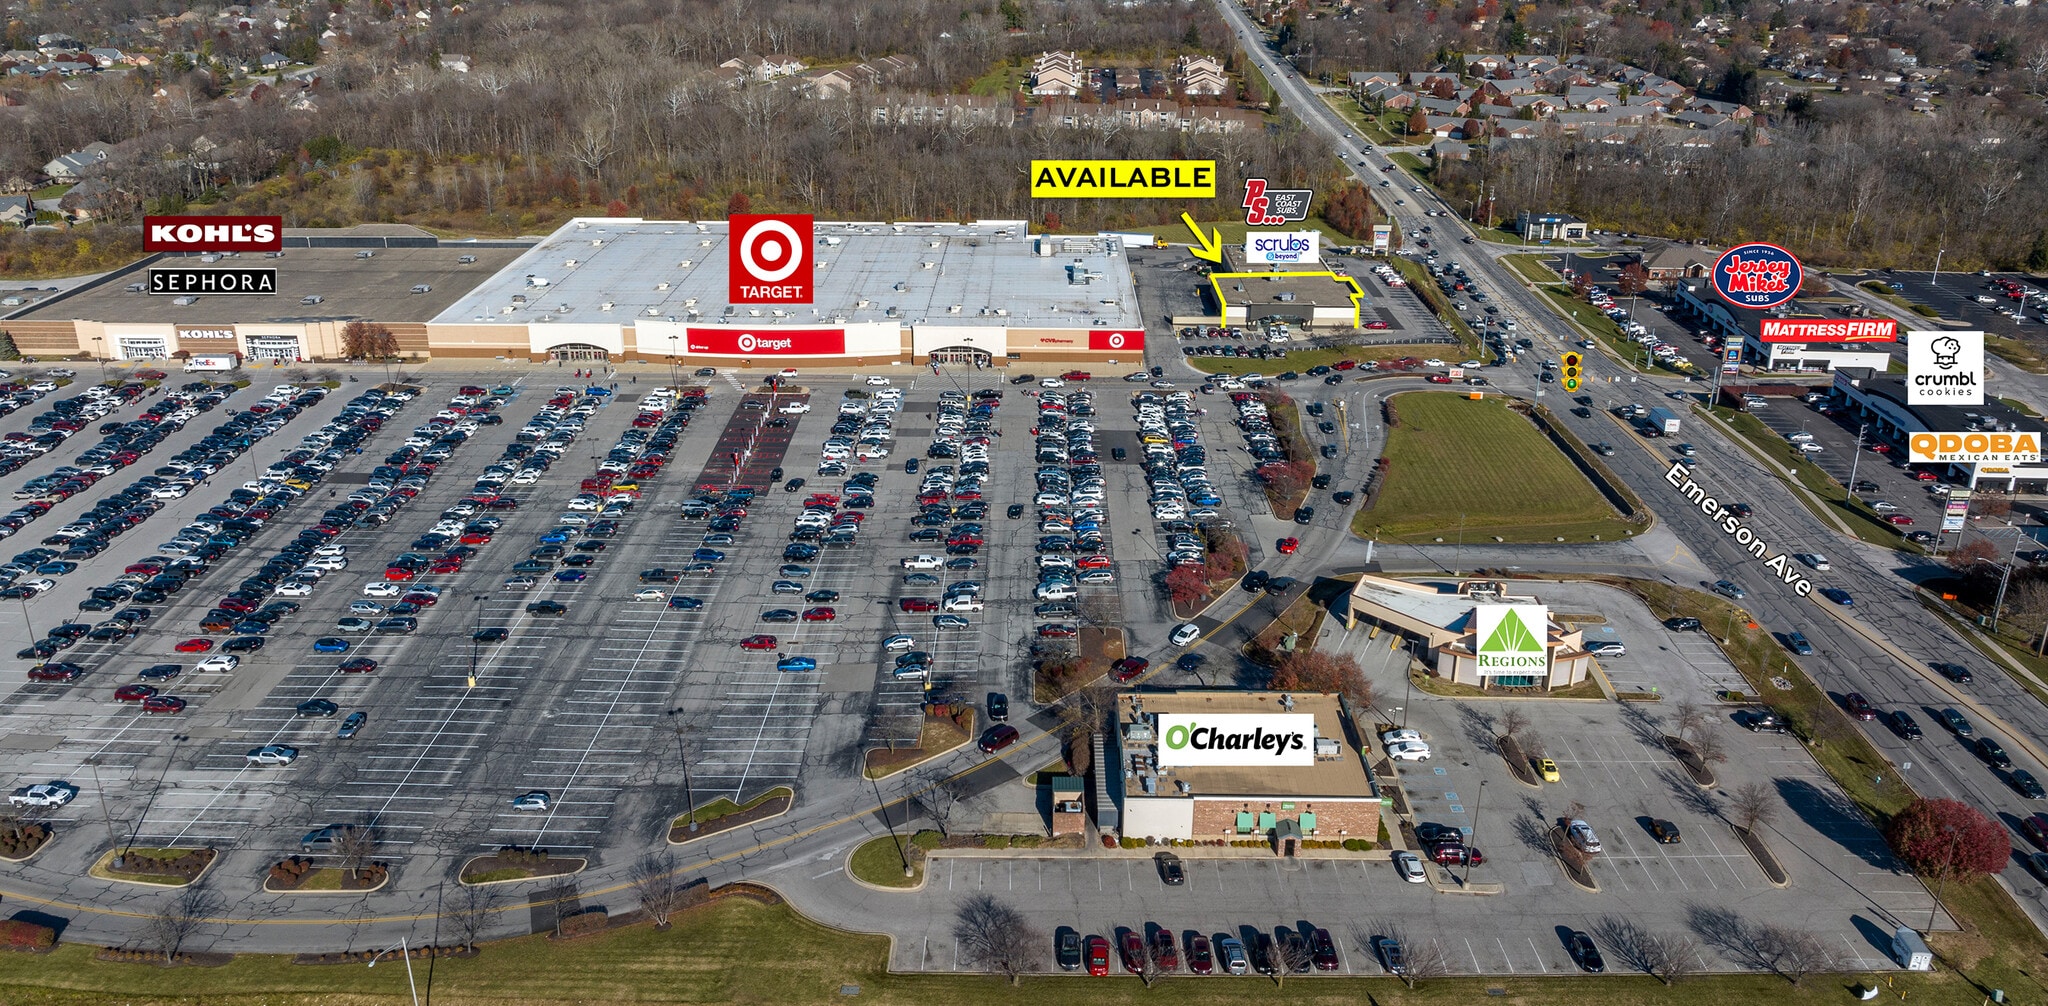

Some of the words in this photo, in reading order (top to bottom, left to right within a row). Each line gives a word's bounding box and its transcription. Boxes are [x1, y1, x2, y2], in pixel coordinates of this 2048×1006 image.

[179, 329, 234, 339] KOHL'S
[756, 337, 792, 350] target
[195, 359, 216, 367] FedEx
